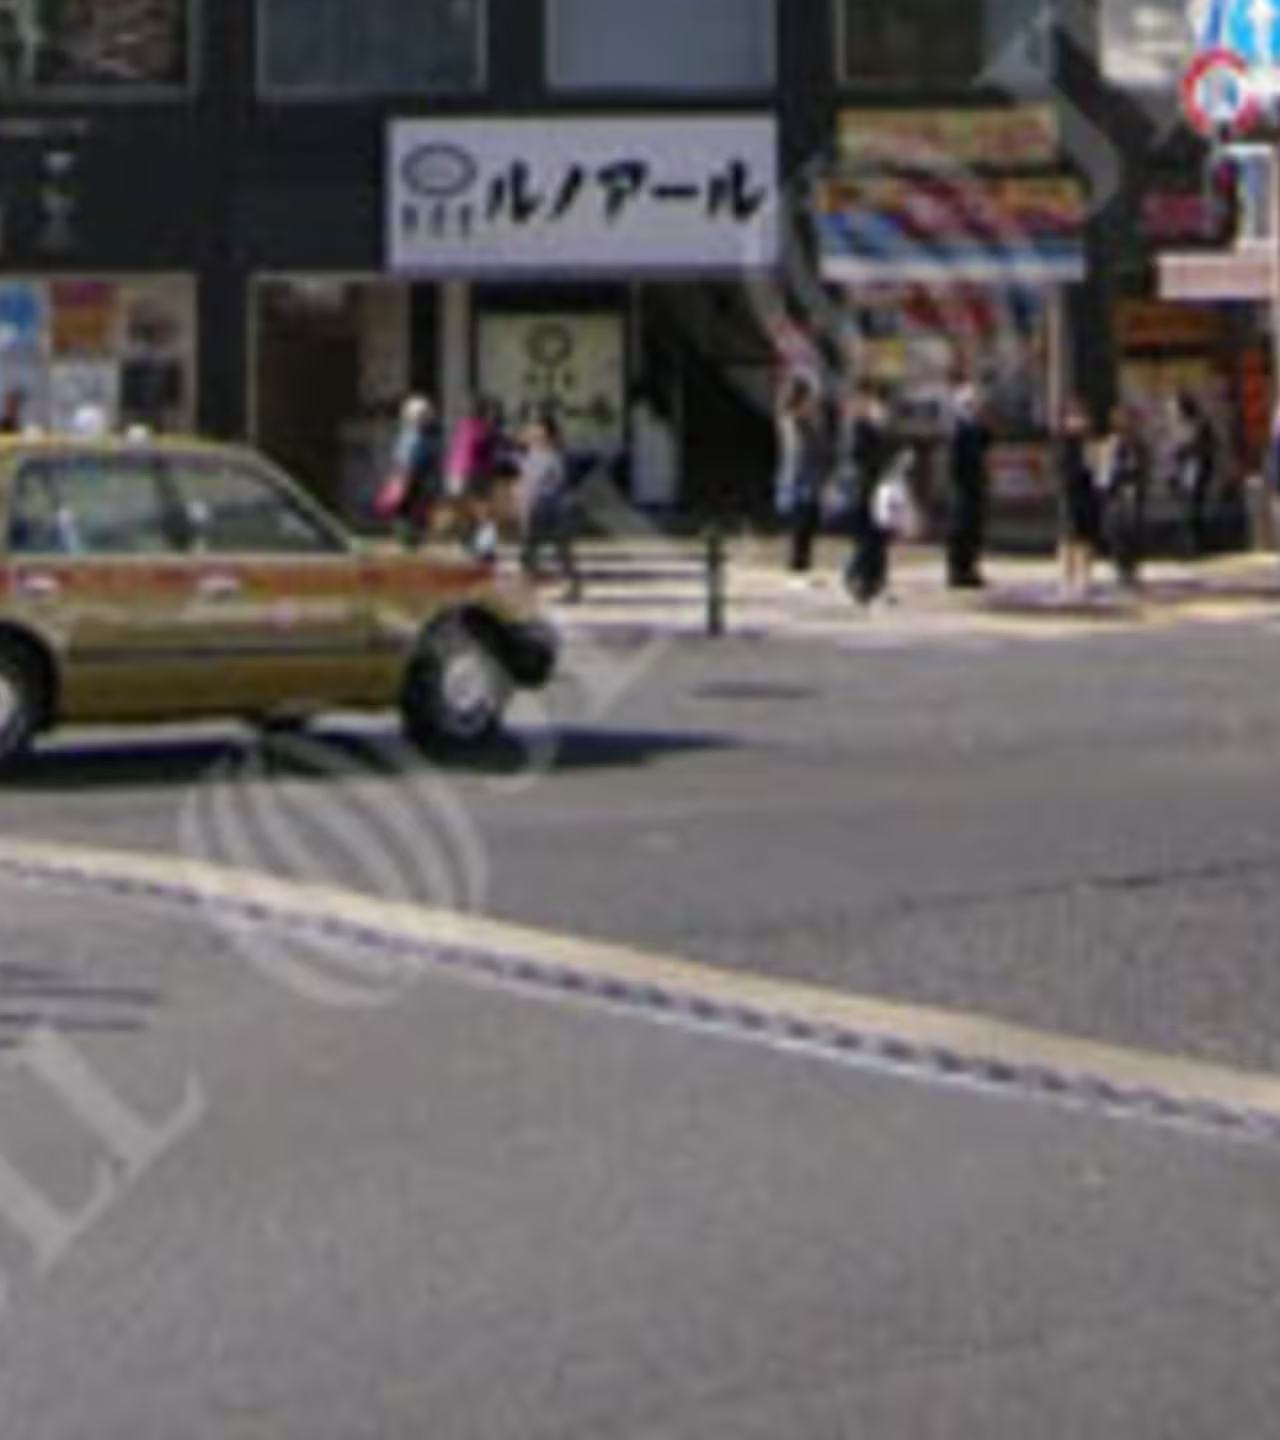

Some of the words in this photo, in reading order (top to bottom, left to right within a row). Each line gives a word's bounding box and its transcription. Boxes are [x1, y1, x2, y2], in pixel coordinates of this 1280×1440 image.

[484, 157, 766, 226] ルノアール
